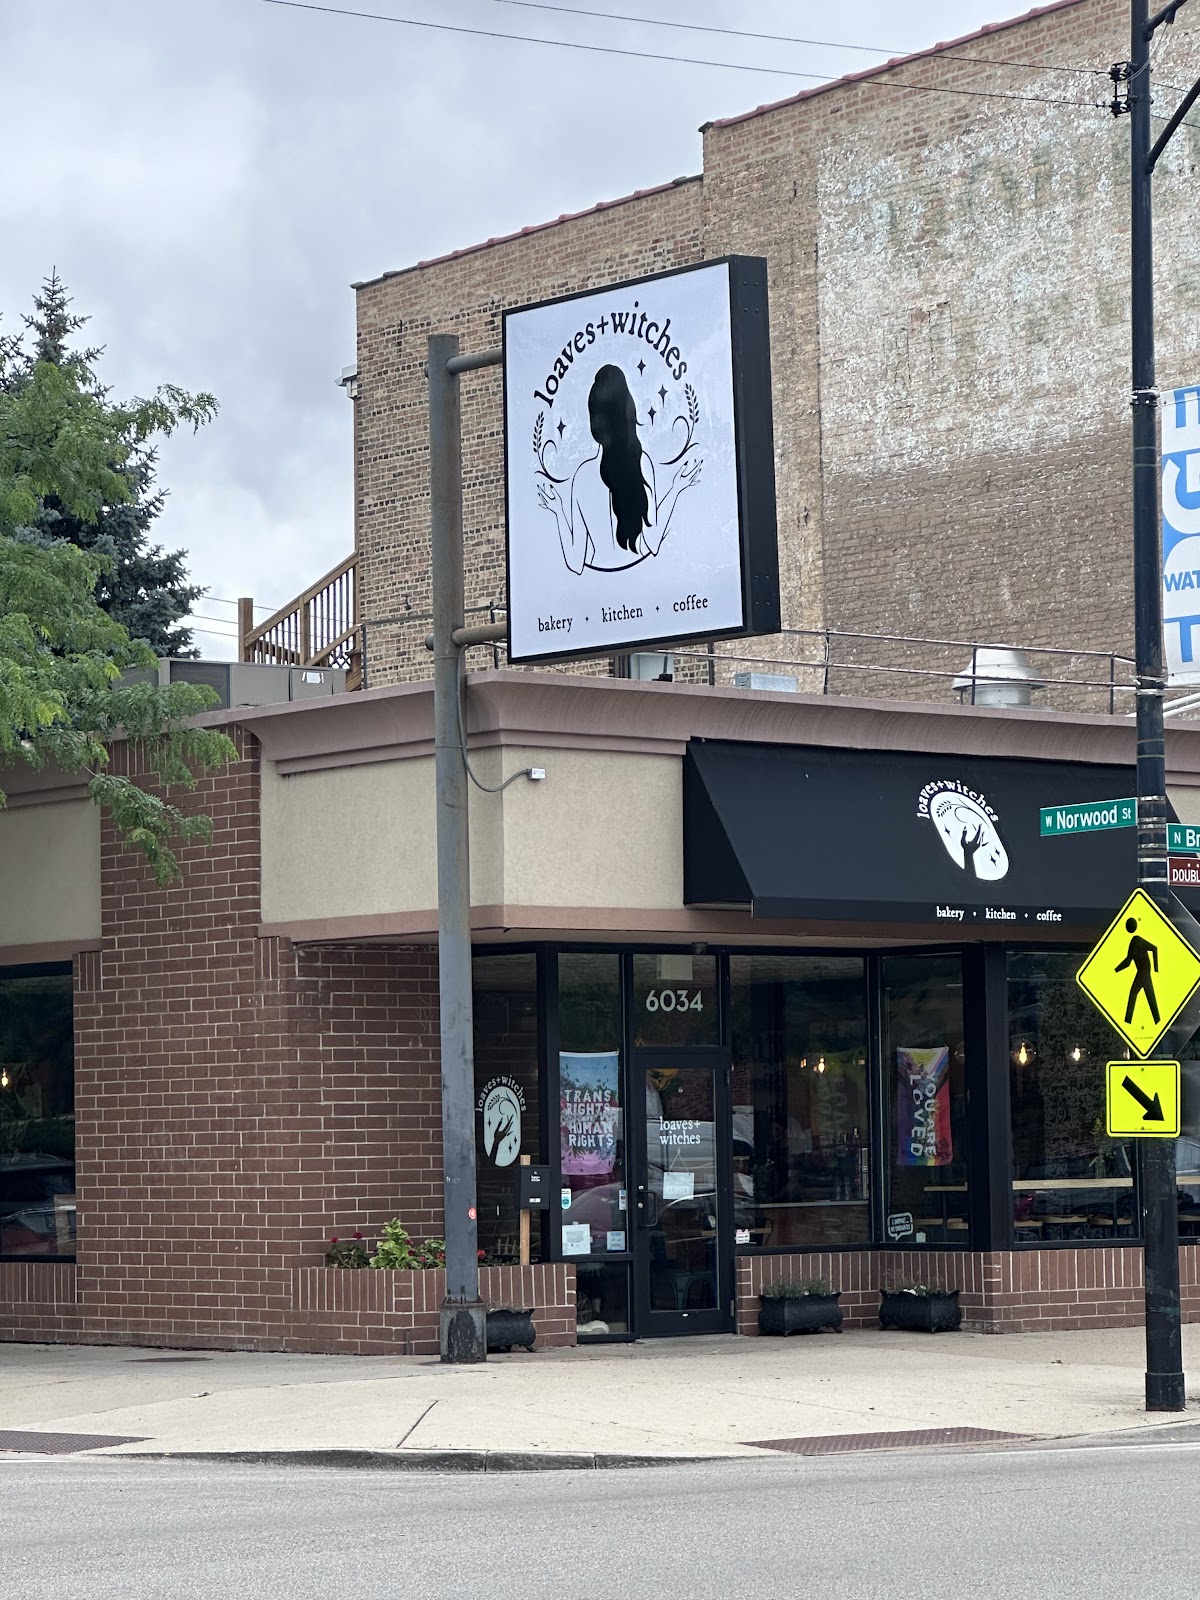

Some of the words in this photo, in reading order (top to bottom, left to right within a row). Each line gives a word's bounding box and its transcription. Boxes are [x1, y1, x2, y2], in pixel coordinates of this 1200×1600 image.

[538, 616, 573, 633] bakery
[602, 605, 643, 624] kitchen
[673, 594, 709, 613] coffee
[1045, 815, 1053, 828] W
[1056, 805, 1118, 830] Norwood
[1122, 807, 1132, 820] St
[1174, 831, 1182, 844] N
[936, 906, 965, 921] bakery
[985, 908, 1017, 920] kitchen
[1036, 909, 1063, 921] coffee
[645, 989, 704, 1013] 6034
[564, 1089, 611, 1103] TRANS
[566, 1102, 611, 1117] RIGHTS
[909, 1074, 927, 1157] LOVED
[569, 1121, 614, 1135] HUMAN
[659, 1115, 701, 1131] loaves+
[568, 1134, 614, 1147] RIGHTS
[659, 1130, 701, 1145] witches
